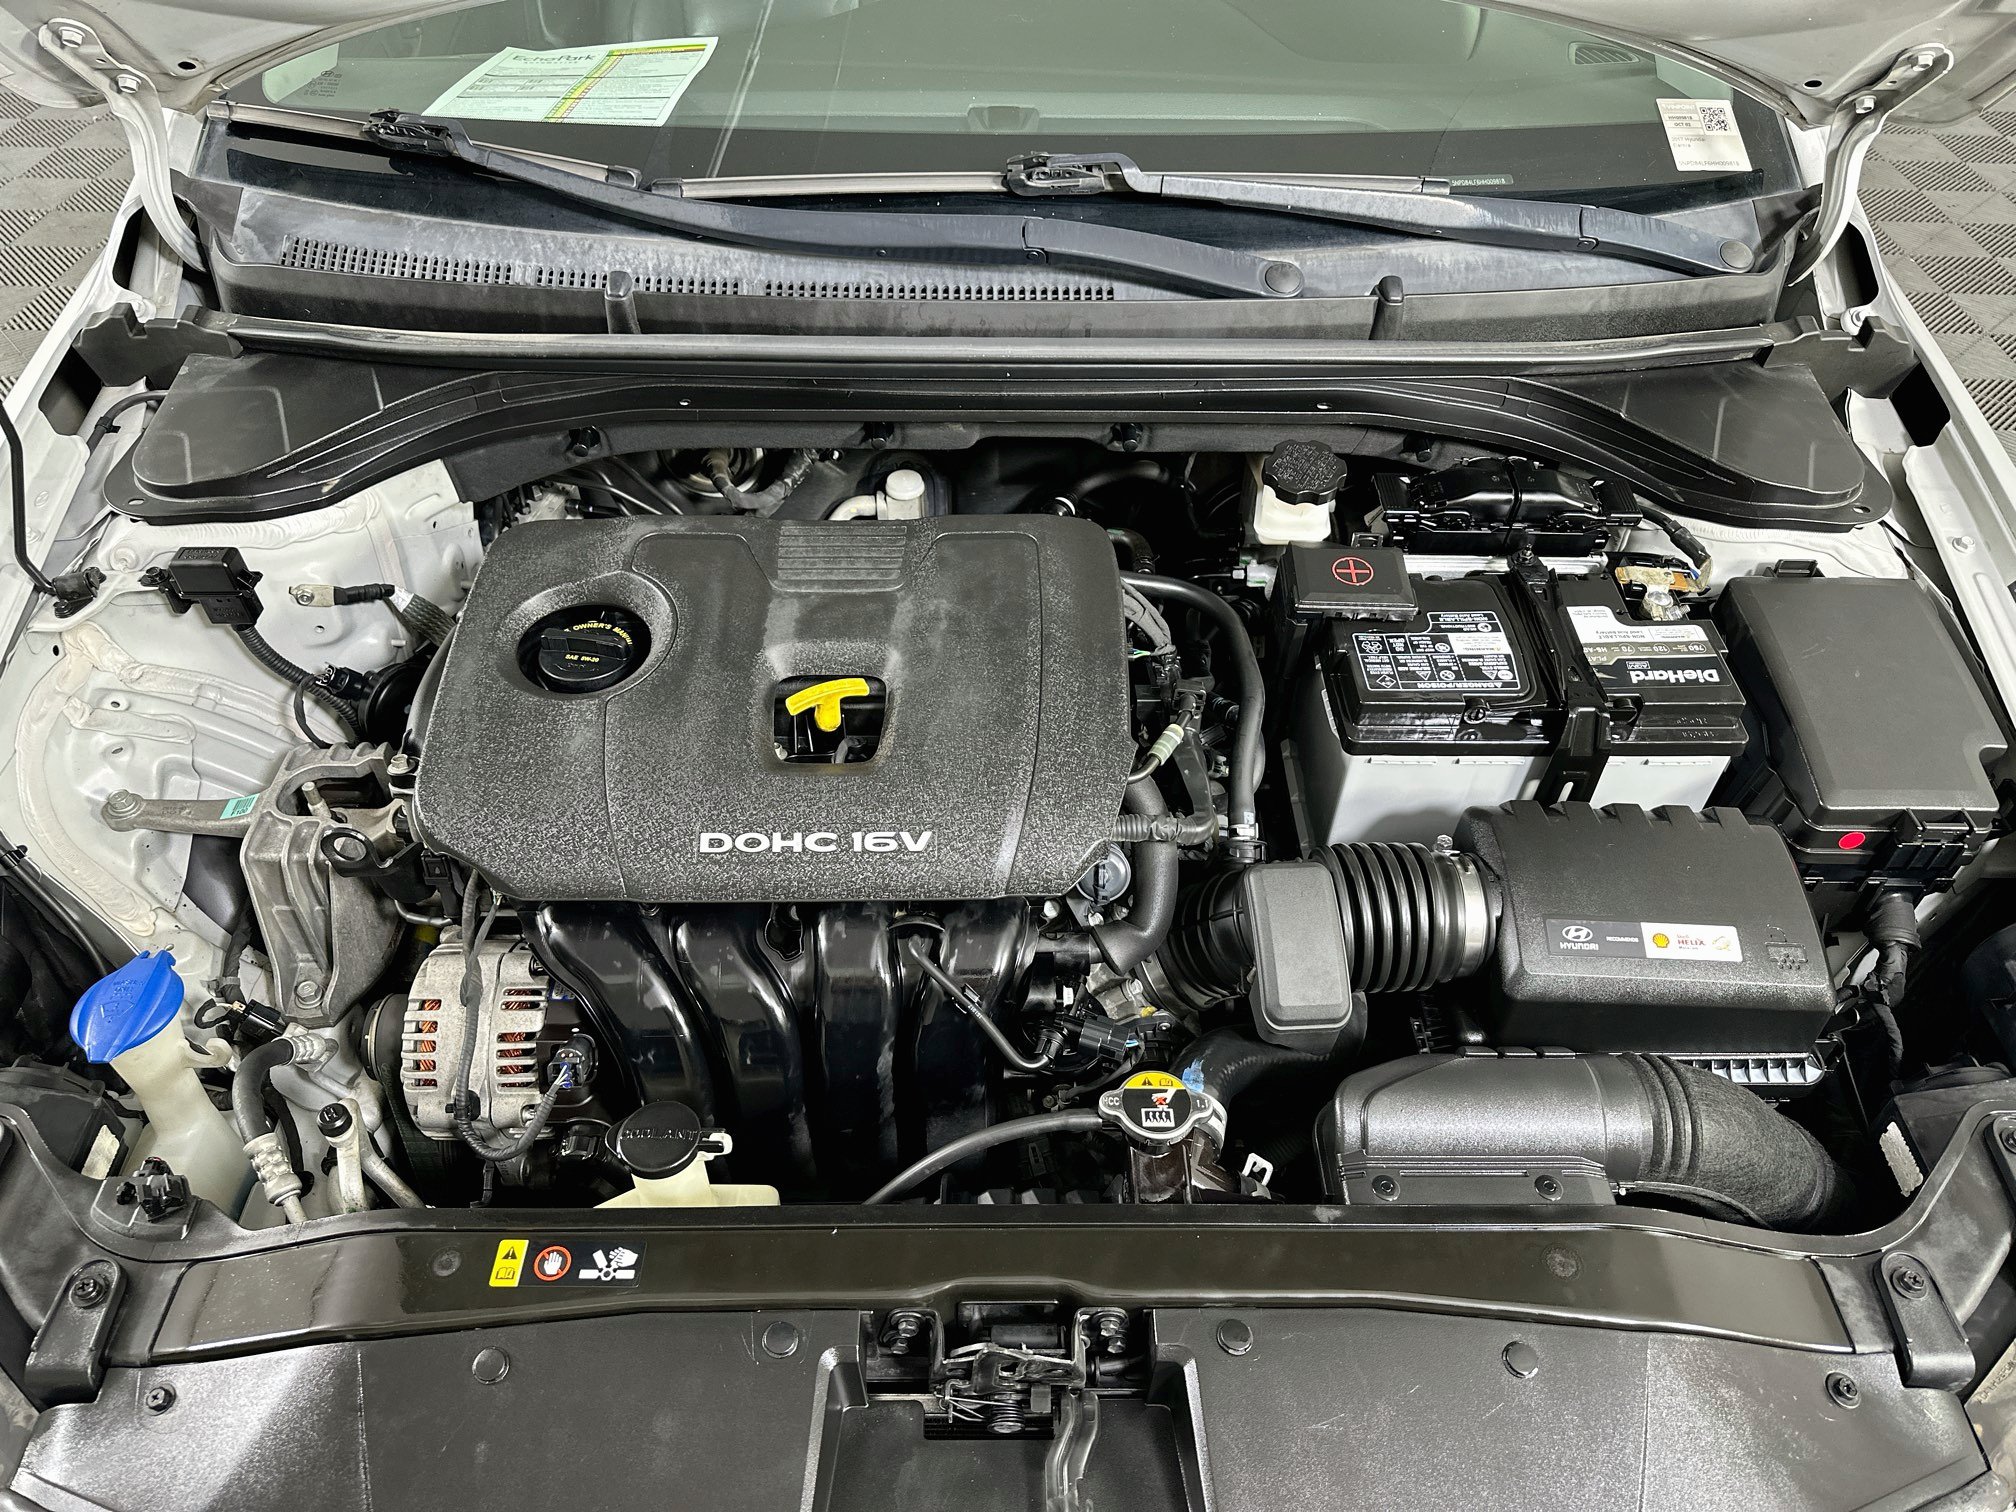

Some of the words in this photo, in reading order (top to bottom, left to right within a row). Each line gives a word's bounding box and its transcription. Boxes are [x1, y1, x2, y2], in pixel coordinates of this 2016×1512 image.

[513, 54, 593, 62] EchoPark
[573, 622, 612, 631] OWNER'S
[565, 653, 579, 661] SAE
[1629, 669, 1720, 683] DieHard
[700, 832, 838, 853] DOHC
[851, 831, 932, 852] 16V
[1559, 942, 1599, 951] HYUNDAI
[1678, 938, 1706, 946] HELIX
[1102, 1096, 1120, 1106] HCC
